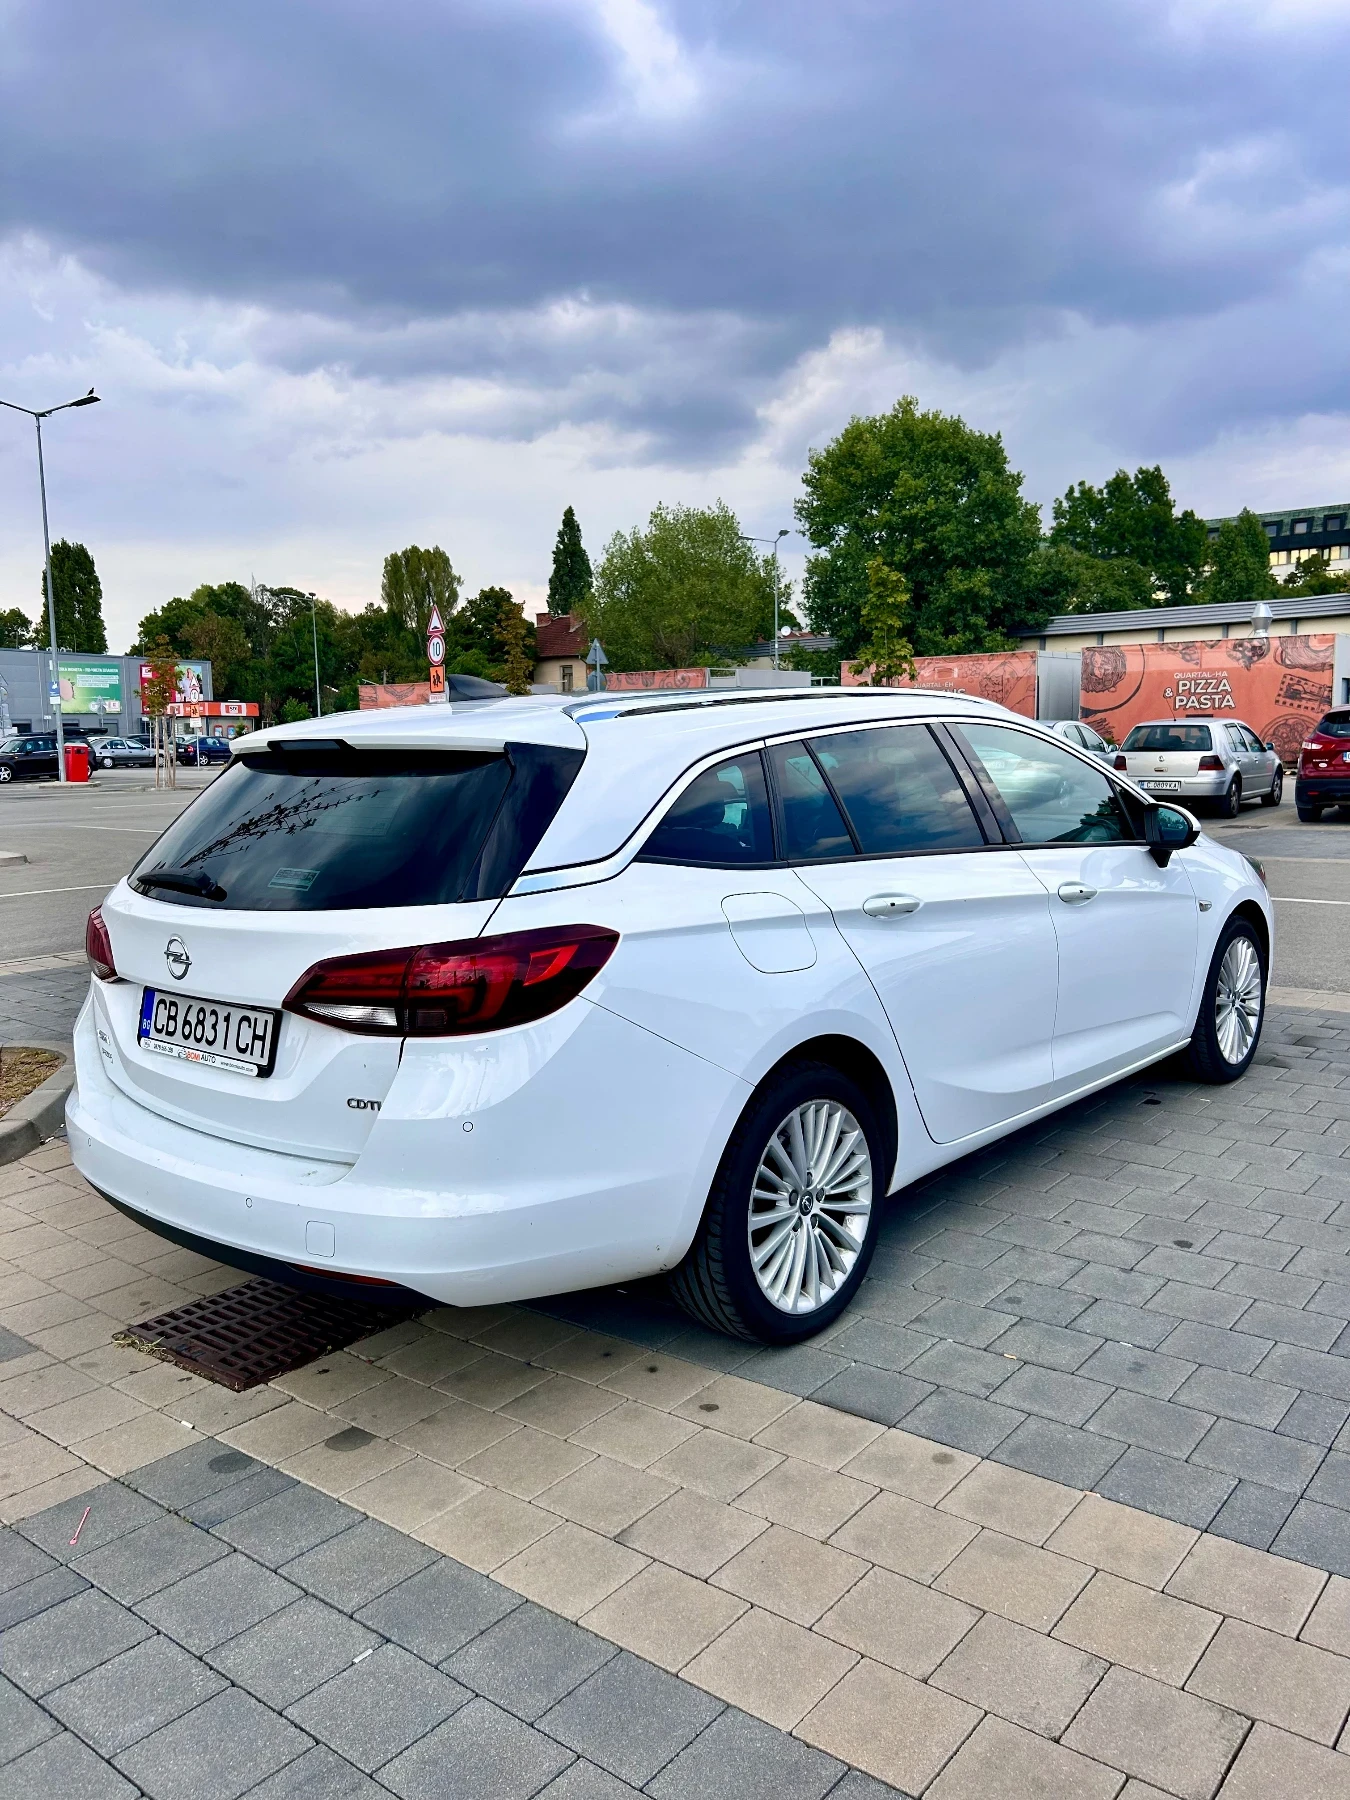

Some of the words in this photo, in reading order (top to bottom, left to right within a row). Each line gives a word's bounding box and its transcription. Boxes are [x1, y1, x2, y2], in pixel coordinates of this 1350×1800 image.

[432, 641, 441, 656] 10
[1173, 671, 1228, 679] QUARTAL-HA
[1164, 687, 1173, 697] &
[1177, 679, 1232, 694] PIZZA
[1174, 694, 1235, 709] PASTA
[201, 1052, 216, 1064] AUTO
[347, 1098, 382, 1111] CDTI
